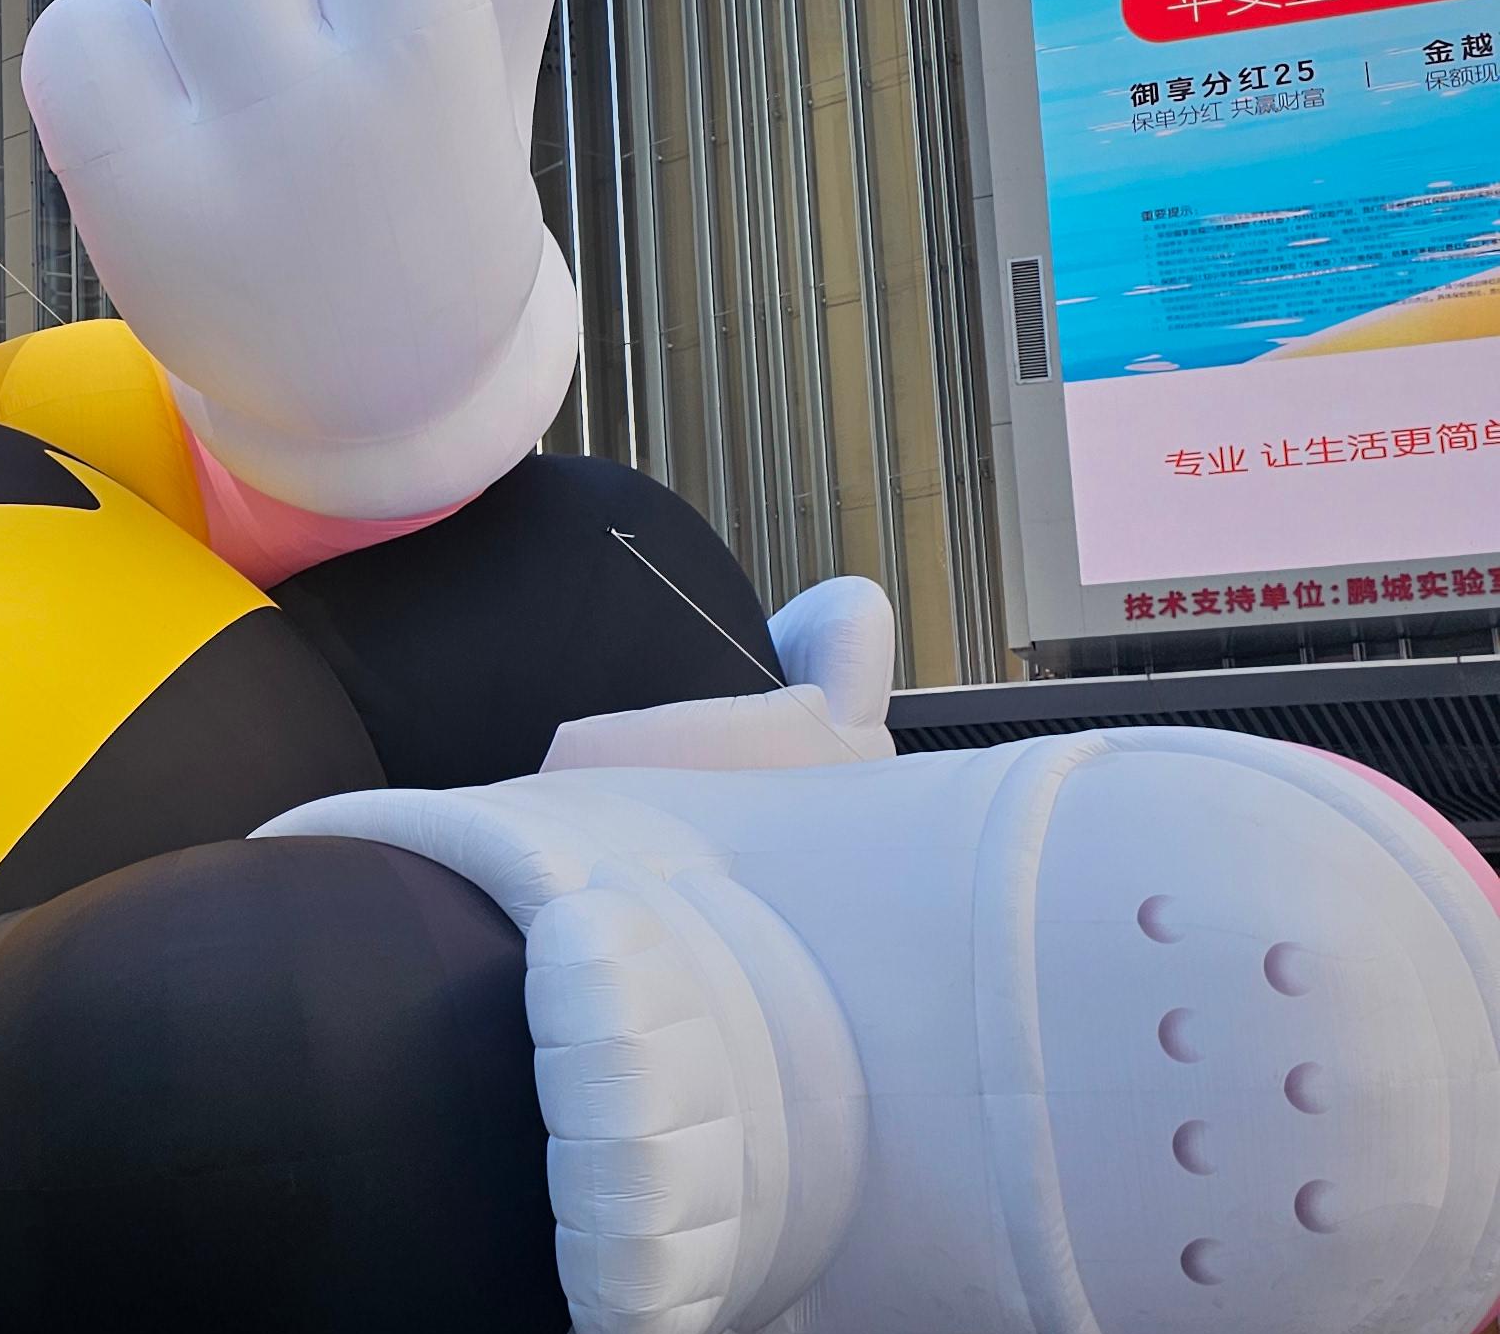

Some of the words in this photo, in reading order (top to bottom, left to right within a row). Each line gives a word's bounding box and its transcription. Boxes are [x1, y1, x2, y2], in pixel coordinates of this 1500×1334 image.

[1129, 59, 1316, 108] 御享分红25
[1131, 101, 1225, 134] 保单分红
[1231, 87, 1325, 120] 共赢财富
[1164, 444, 1249, 476] 专业
